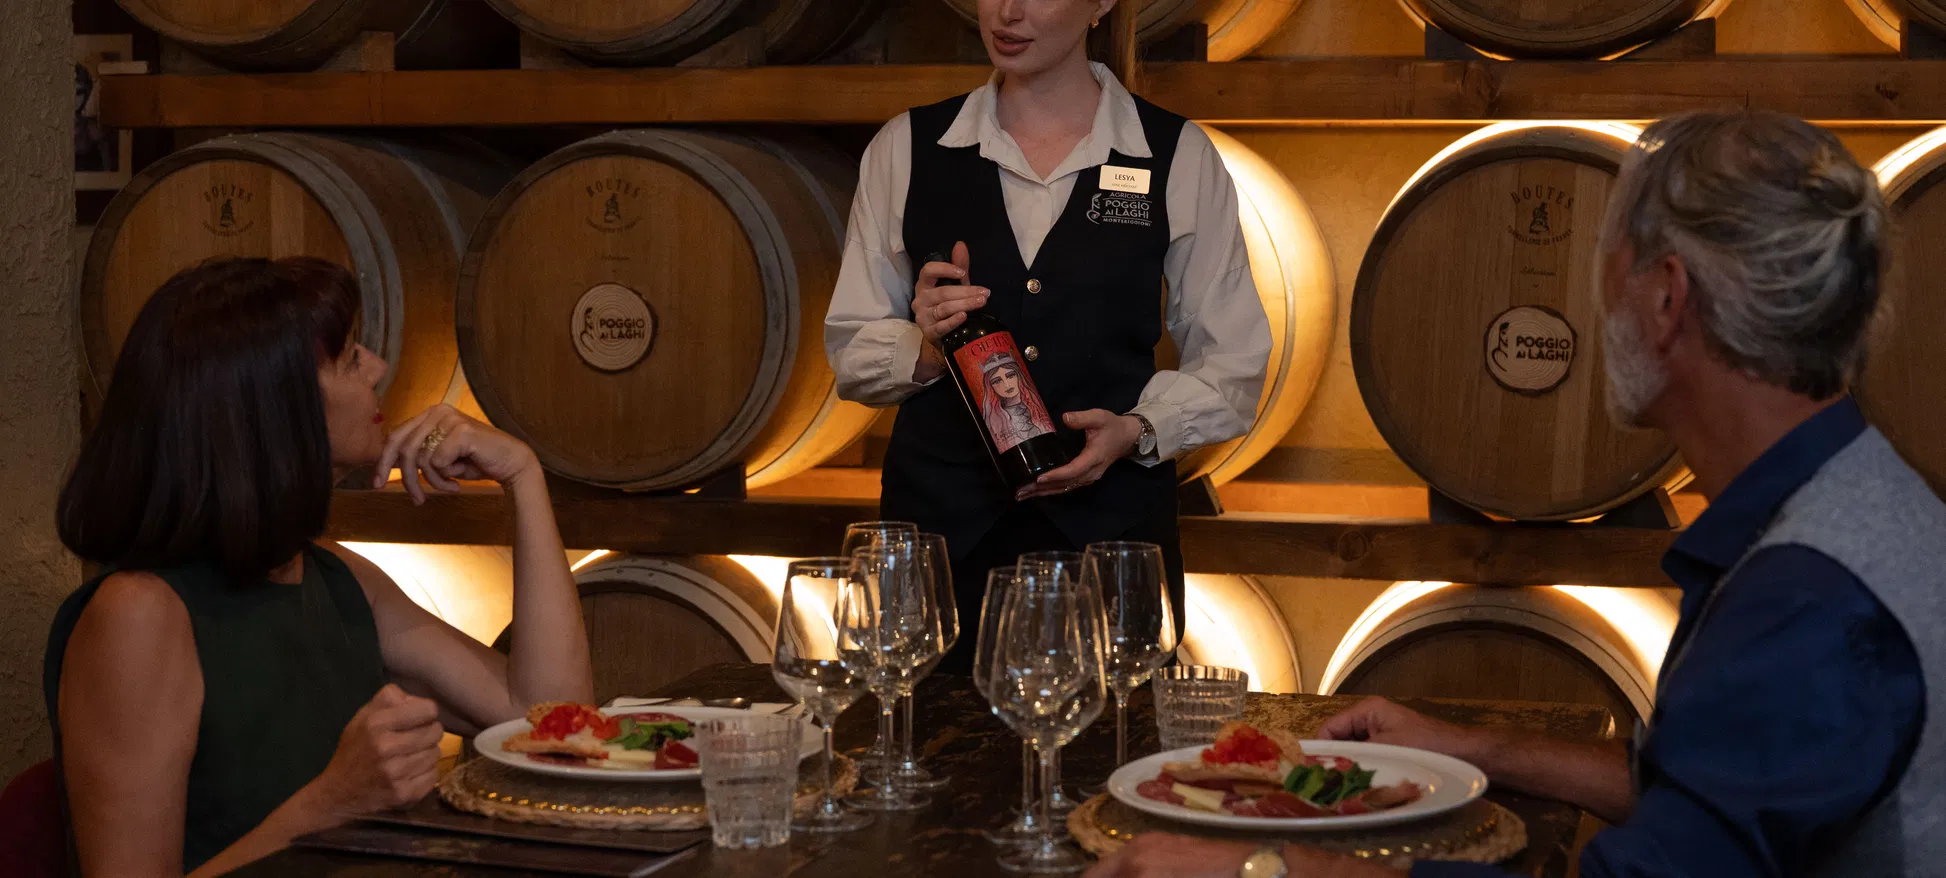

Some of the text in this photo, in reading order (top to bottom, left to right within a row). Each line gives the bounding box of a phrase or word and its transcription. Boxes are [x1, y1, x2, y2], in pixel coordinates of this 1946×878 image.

[1114, 173, 1136, 182] LESYA
[1109, 191, 1147, 200] AGRICOLA
[1509, 184, 1574, 209] BOUTES
[1105, 199, 1150, 211] POGGIO
[1115, 208, 1149, 219] LAGHI
[599, 318, 645, 329] POGGIO
[610, 329, 645, 339] LAGHI
[1516, 335, 1570, 349] POGGIO
[1516, 349, 1569, 362] AI LAGHI
